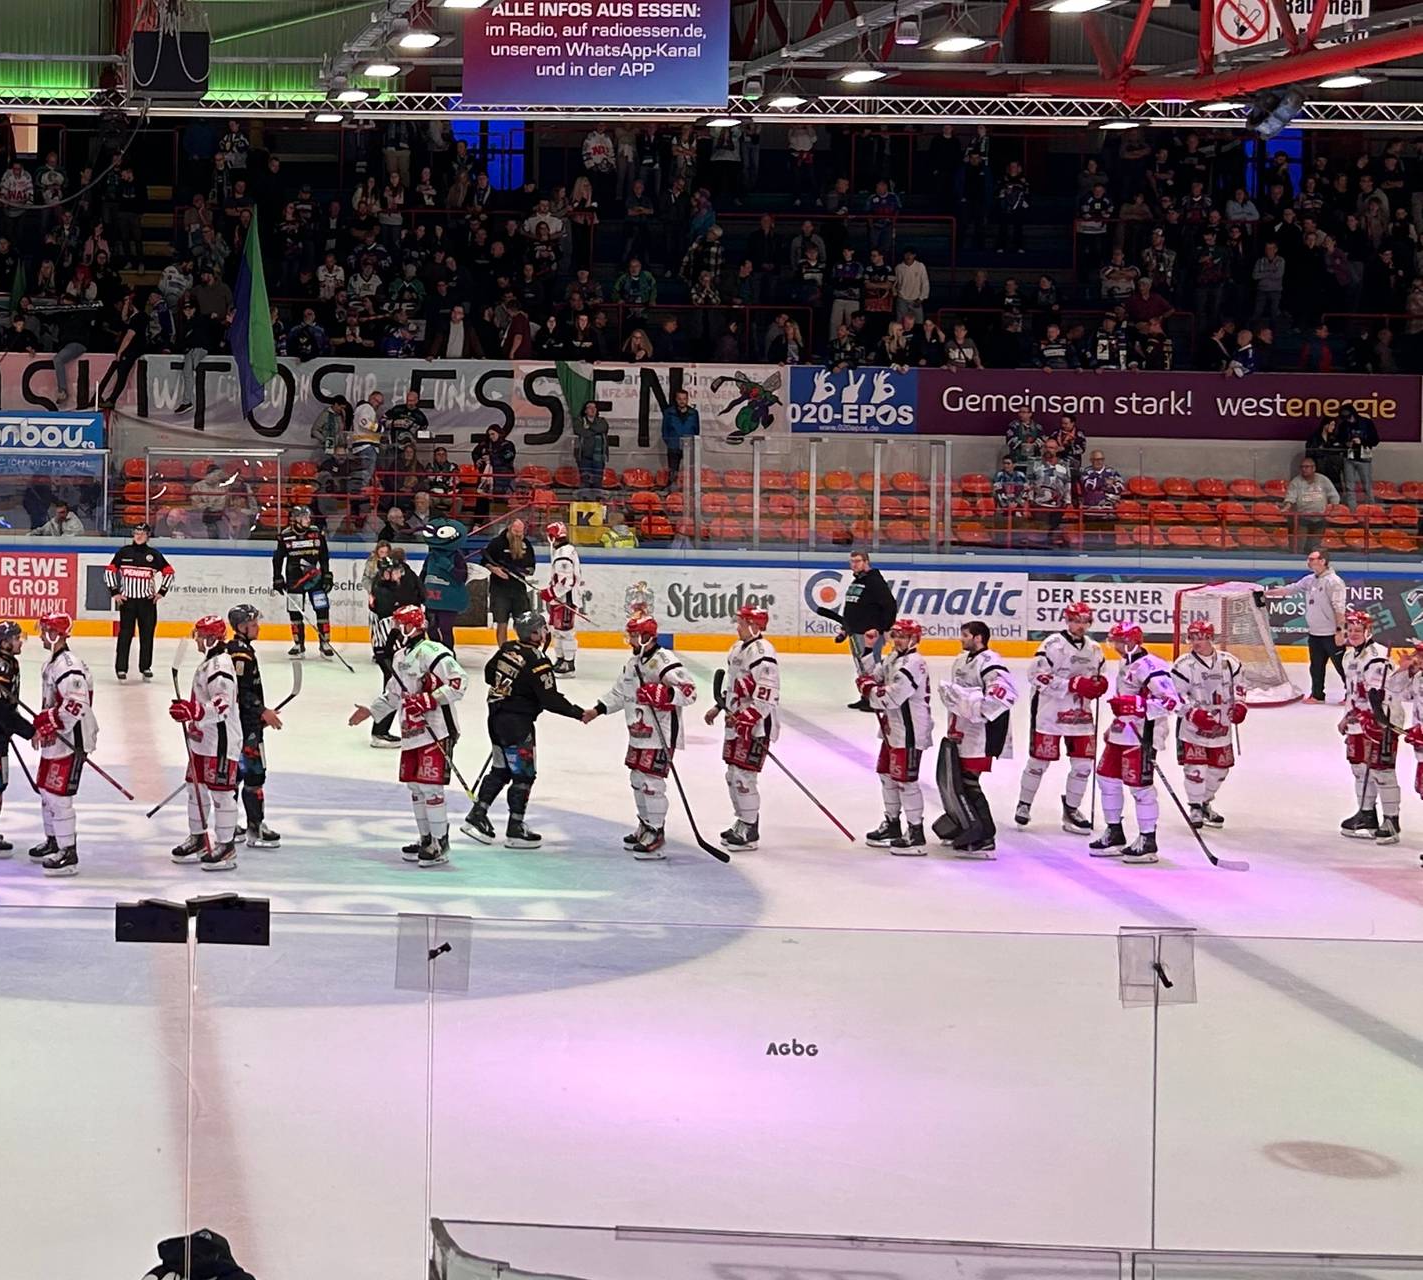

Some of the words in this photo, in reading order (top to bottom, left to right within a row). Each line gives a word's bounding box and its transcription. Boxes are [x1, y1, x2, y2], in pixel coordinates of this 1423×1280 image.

[492, 2, 535, 17] ALLE
[539, 3, 593, 17] INFOS
[596, 3, 634, 17] AUS
[638, 3, 701, 18] ESSEN:
[486, 22, 505, 37] im
[509, 22, 558, 39] Radio,
[562, 22, 588, 37] auf
[592, 23, 707, 40] radioessen.de,
[491, 44, 561, 57] unserem
[566, 42, 701, 60] WhatsApp-Kanal
[536, 63, 565, 76] und
[569, 63, 584, 76] in
[589, 63, 616, 76] der
[619, 63, 655, 77] APP
[942, 387, 1104, 415] Gemeinsam
[1114, 390, 1192, 416] stark!
[1, 557, 69, 578] REWE
[9, 579, 59, 596] GROB
[183, 586, 218, 594] steuern
[221, 586, 246, 594] Ihren
[1037, 588, 1074, 602] DER
[1080, 590, 1163, 604] ESSENER
[0, 597, 26, 616] DEIN
[29, 598, 68, 617] MARKT
[667, 583, 775, 622] Stauder
